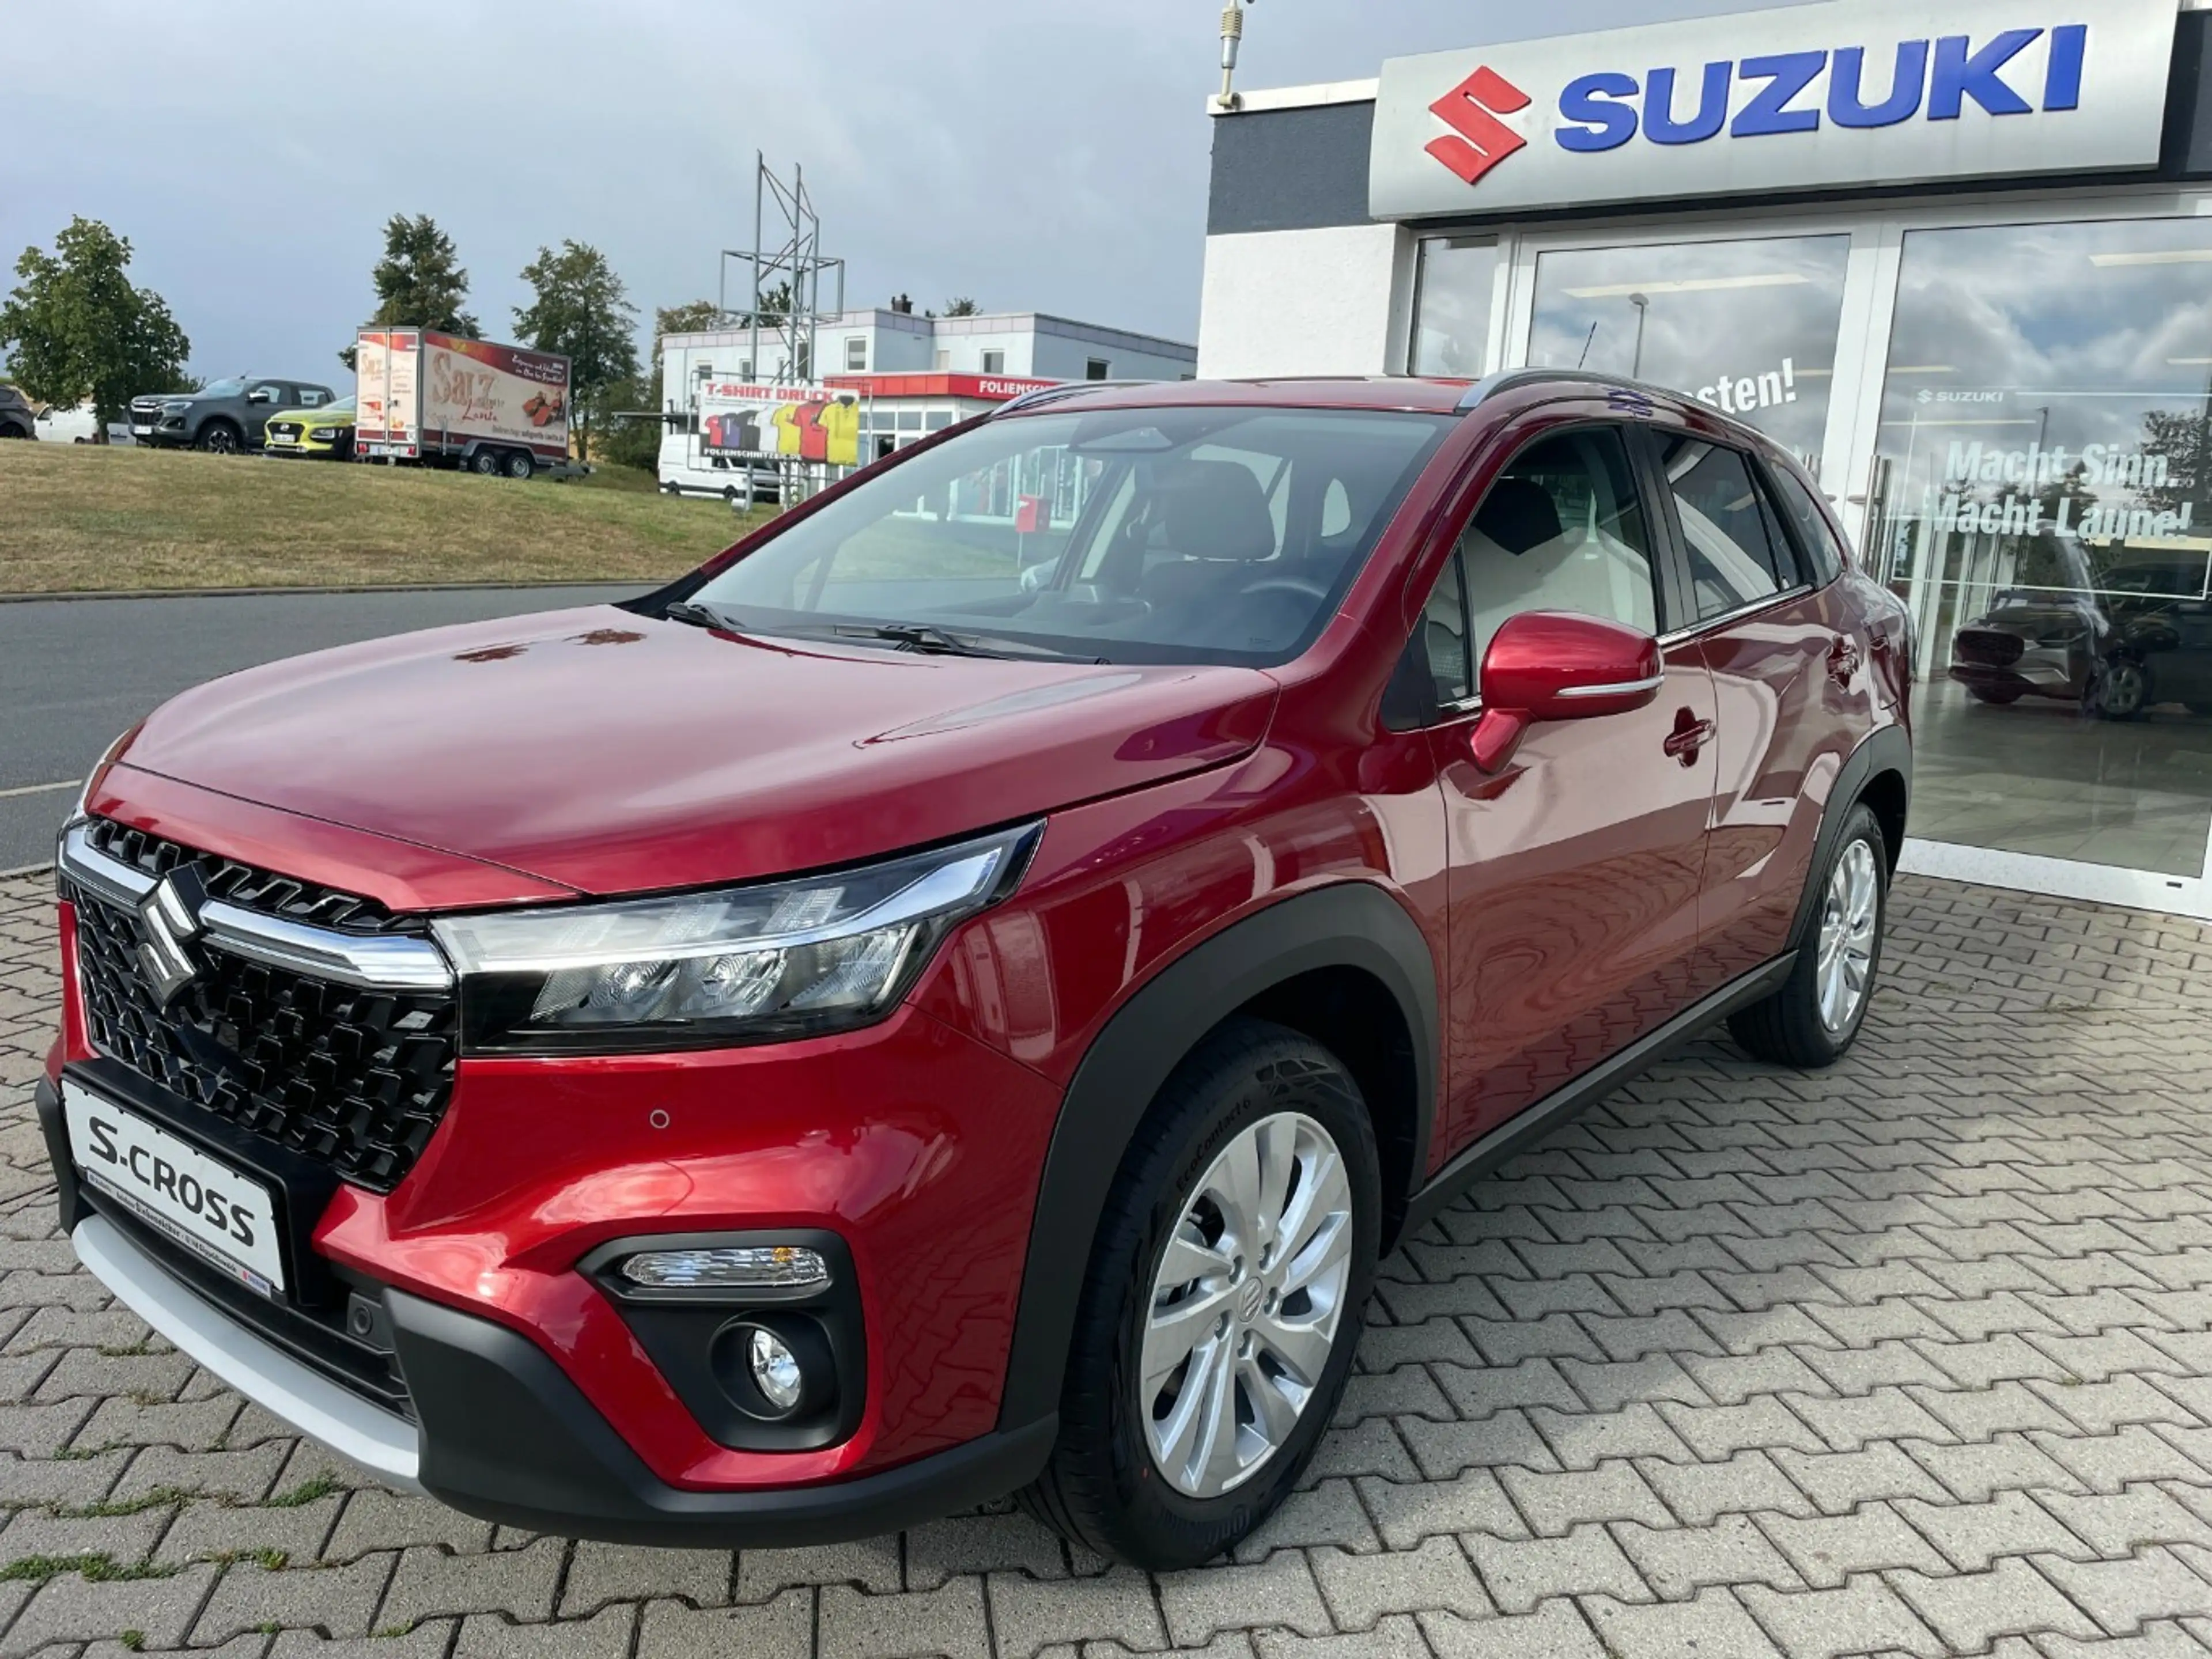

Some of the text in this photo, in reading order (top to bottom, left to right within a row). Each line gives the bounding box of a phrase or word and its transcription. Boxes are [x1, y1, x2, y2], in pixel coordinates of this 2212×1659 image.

[1556, 24, 2087, 153] SUZUKI
[706, 384, 773, 399] T-SHIRT
[777, 389, 835, 403] DRUCK
[1682, 357, 1797, 414] sten!
[1936, 392, 2003, 403] SUZUKI
[1945, 441, 2181, 487] Macht Sinn.
[1922, 493, 2193, 542] Macht Laune!
[89, 1116, 255, 1247] S.CROSS
